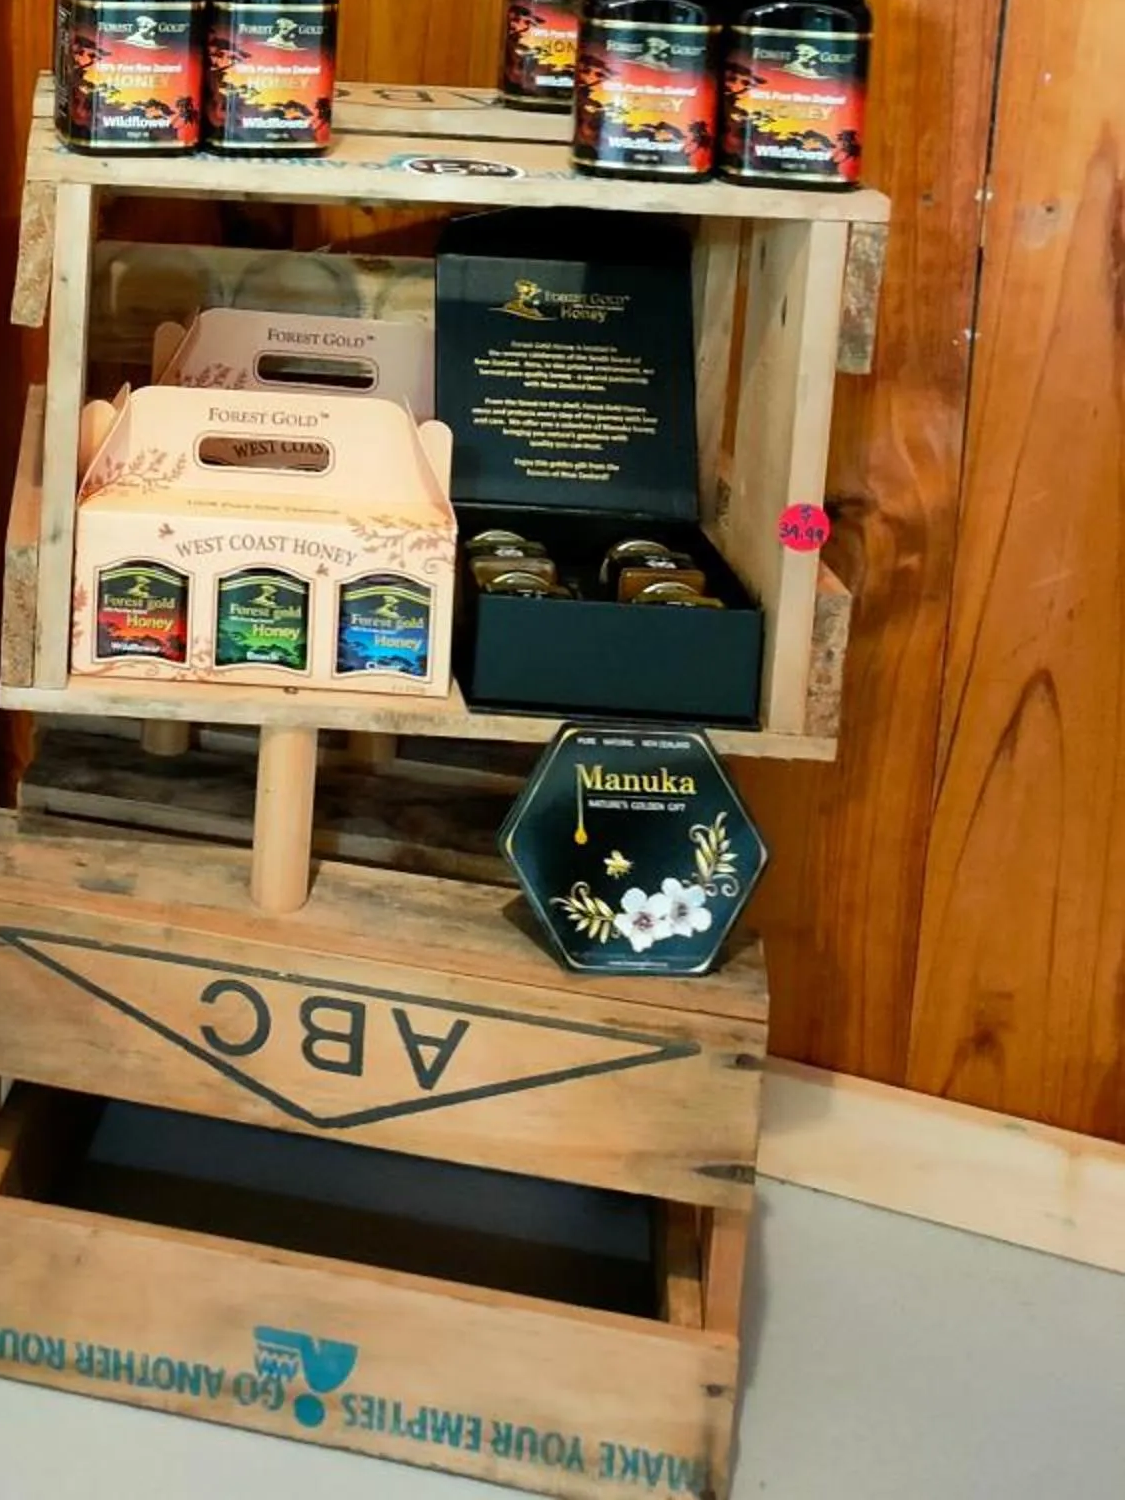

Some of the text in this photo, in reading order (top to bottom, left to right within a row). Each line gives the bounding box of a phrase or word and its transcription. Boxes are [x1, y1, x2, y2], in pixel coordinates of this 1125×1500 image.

[103, 115, 172, 128] Wildflower
[268, 328, 365, 349] FOREST GOLD
[208, 407, 319, 427] FOREST GOLD
[233, 440, 325, 459] WEST COAS
[176, 534, 359, 568] WEST COAST HONEY
[127, 613, 174, 632] Honey
[229, 603, 271, 617] Forest
[252, 623, 301, 640] Honey
[374, 634, 423, 652] Honey
[574, 763, 697, 795] Manuka
[200, 978, 471, 1091] ABC
[74, 1342, 226, 1399] ANOTHER
[232, 1371, 285, 1412] GO
[342, 1391, 483, 1454] EMPTIES
[490, 1420, 586, 1474] YOUR
[598, 1441, 711, 1496] MAKE
